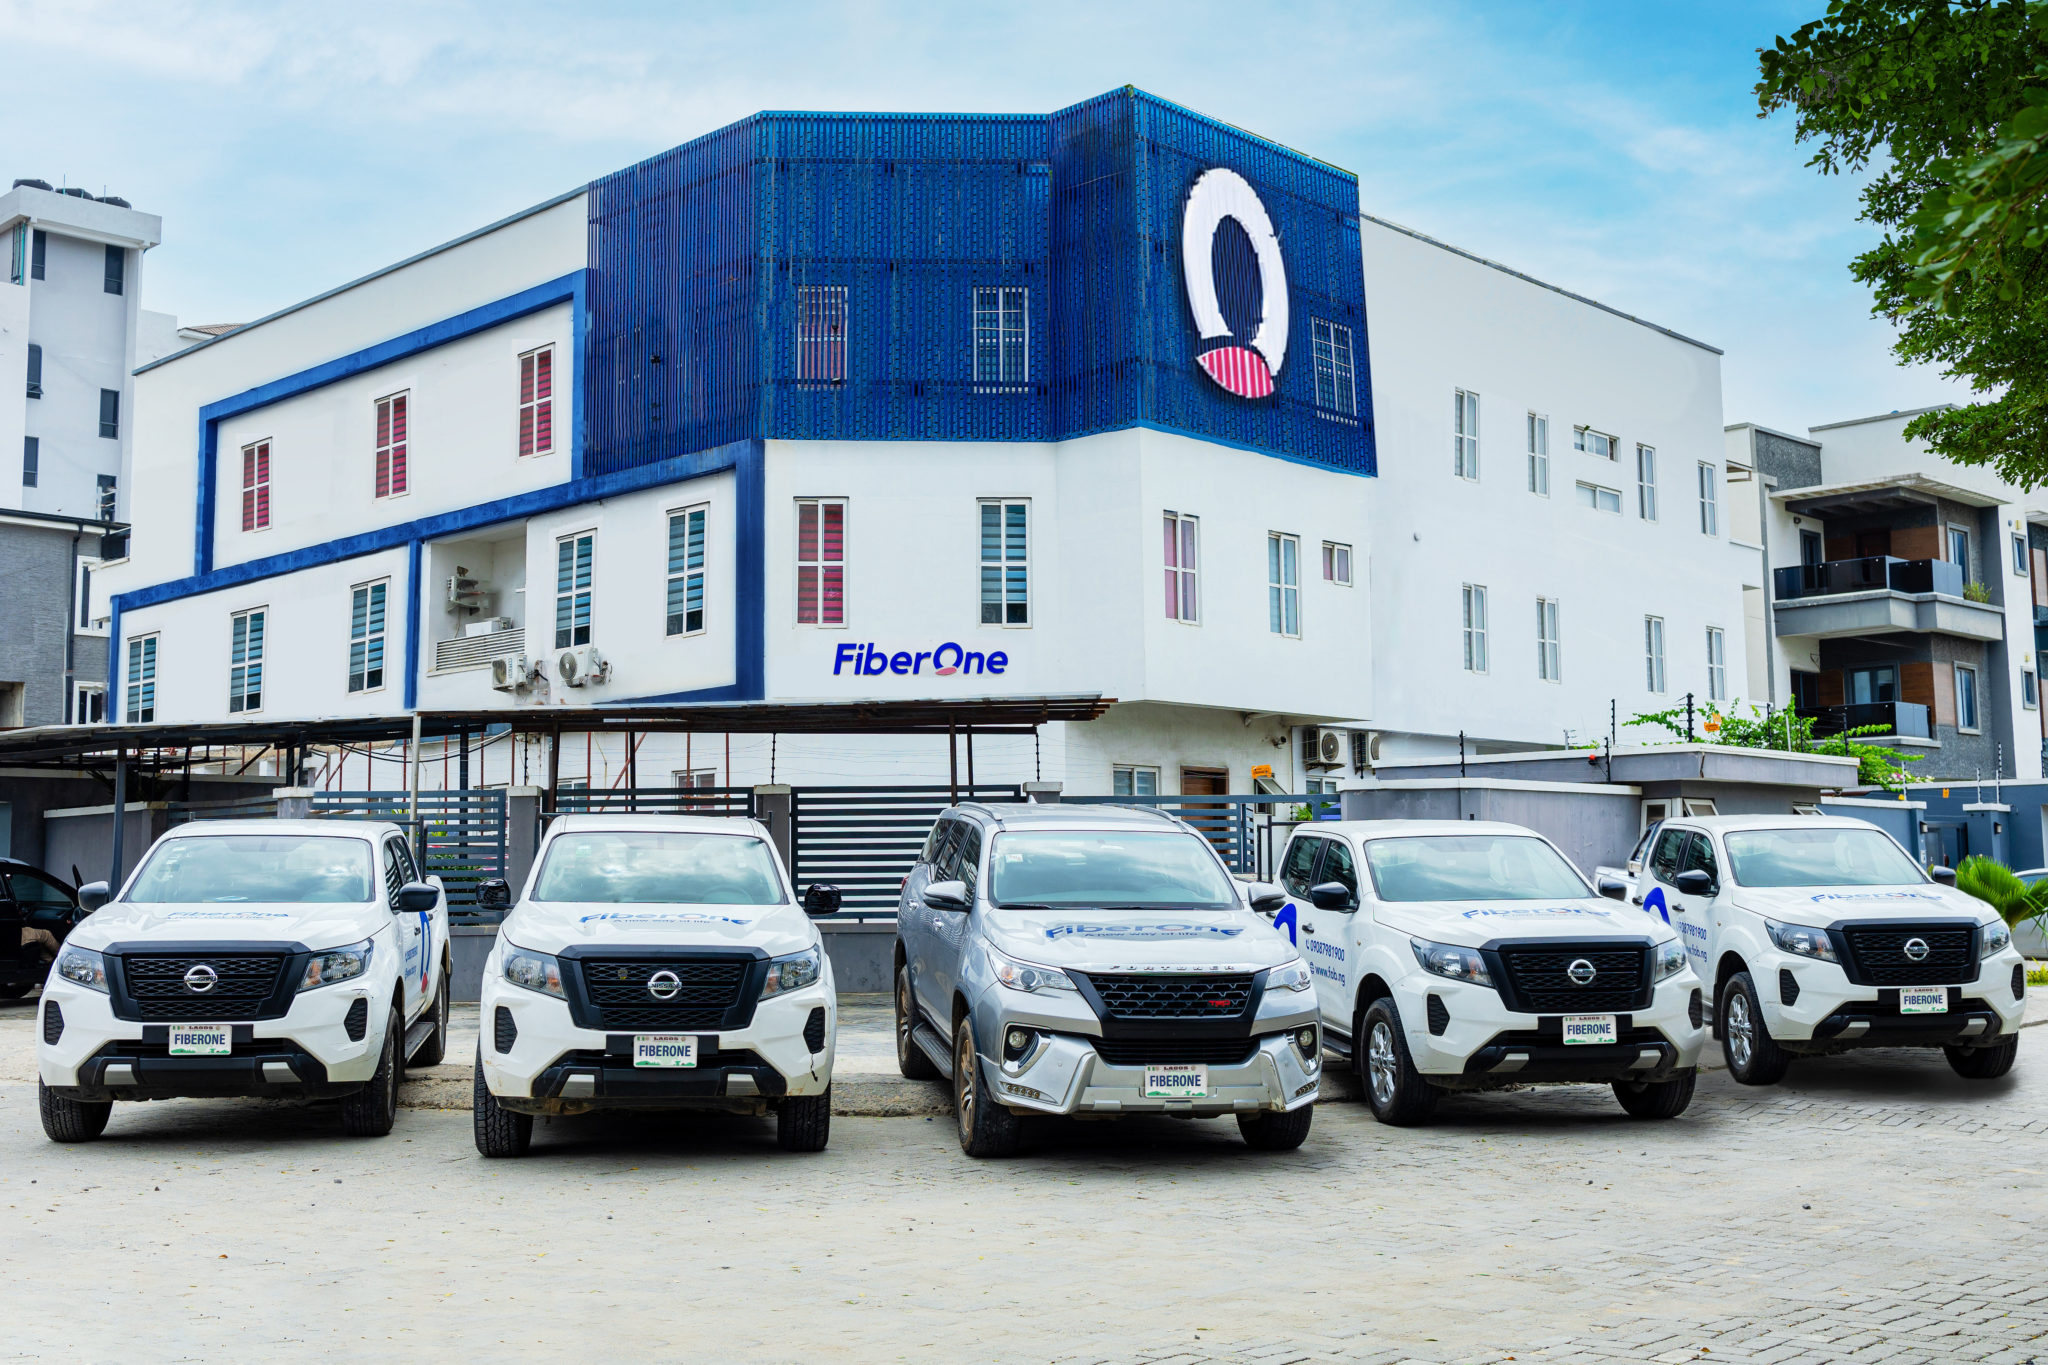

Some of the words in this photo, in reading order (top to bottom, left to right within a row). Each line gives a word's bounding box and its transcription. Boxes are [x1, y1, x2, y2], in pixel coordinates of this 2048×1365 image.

[833, 642, 1009, 676] FiberOne
[578, 912, 753, 926] FiberOne
[1045, 923, 1245, 939] FiberOne
[1310, 939, 1345, 962] 09087981900
[1315, 965, 1346, 987] www.fob.ng
[1904, 994, 1943, 1005] FIBERONE
[1567, 1023, 1611, 1035] FIBERONE
[174, 1033, 226, 1045] FIBERONE
[639, 1045, 691, 1057] FIBERONE
[1149, 1074, 1202, 1087] FIBERONE
